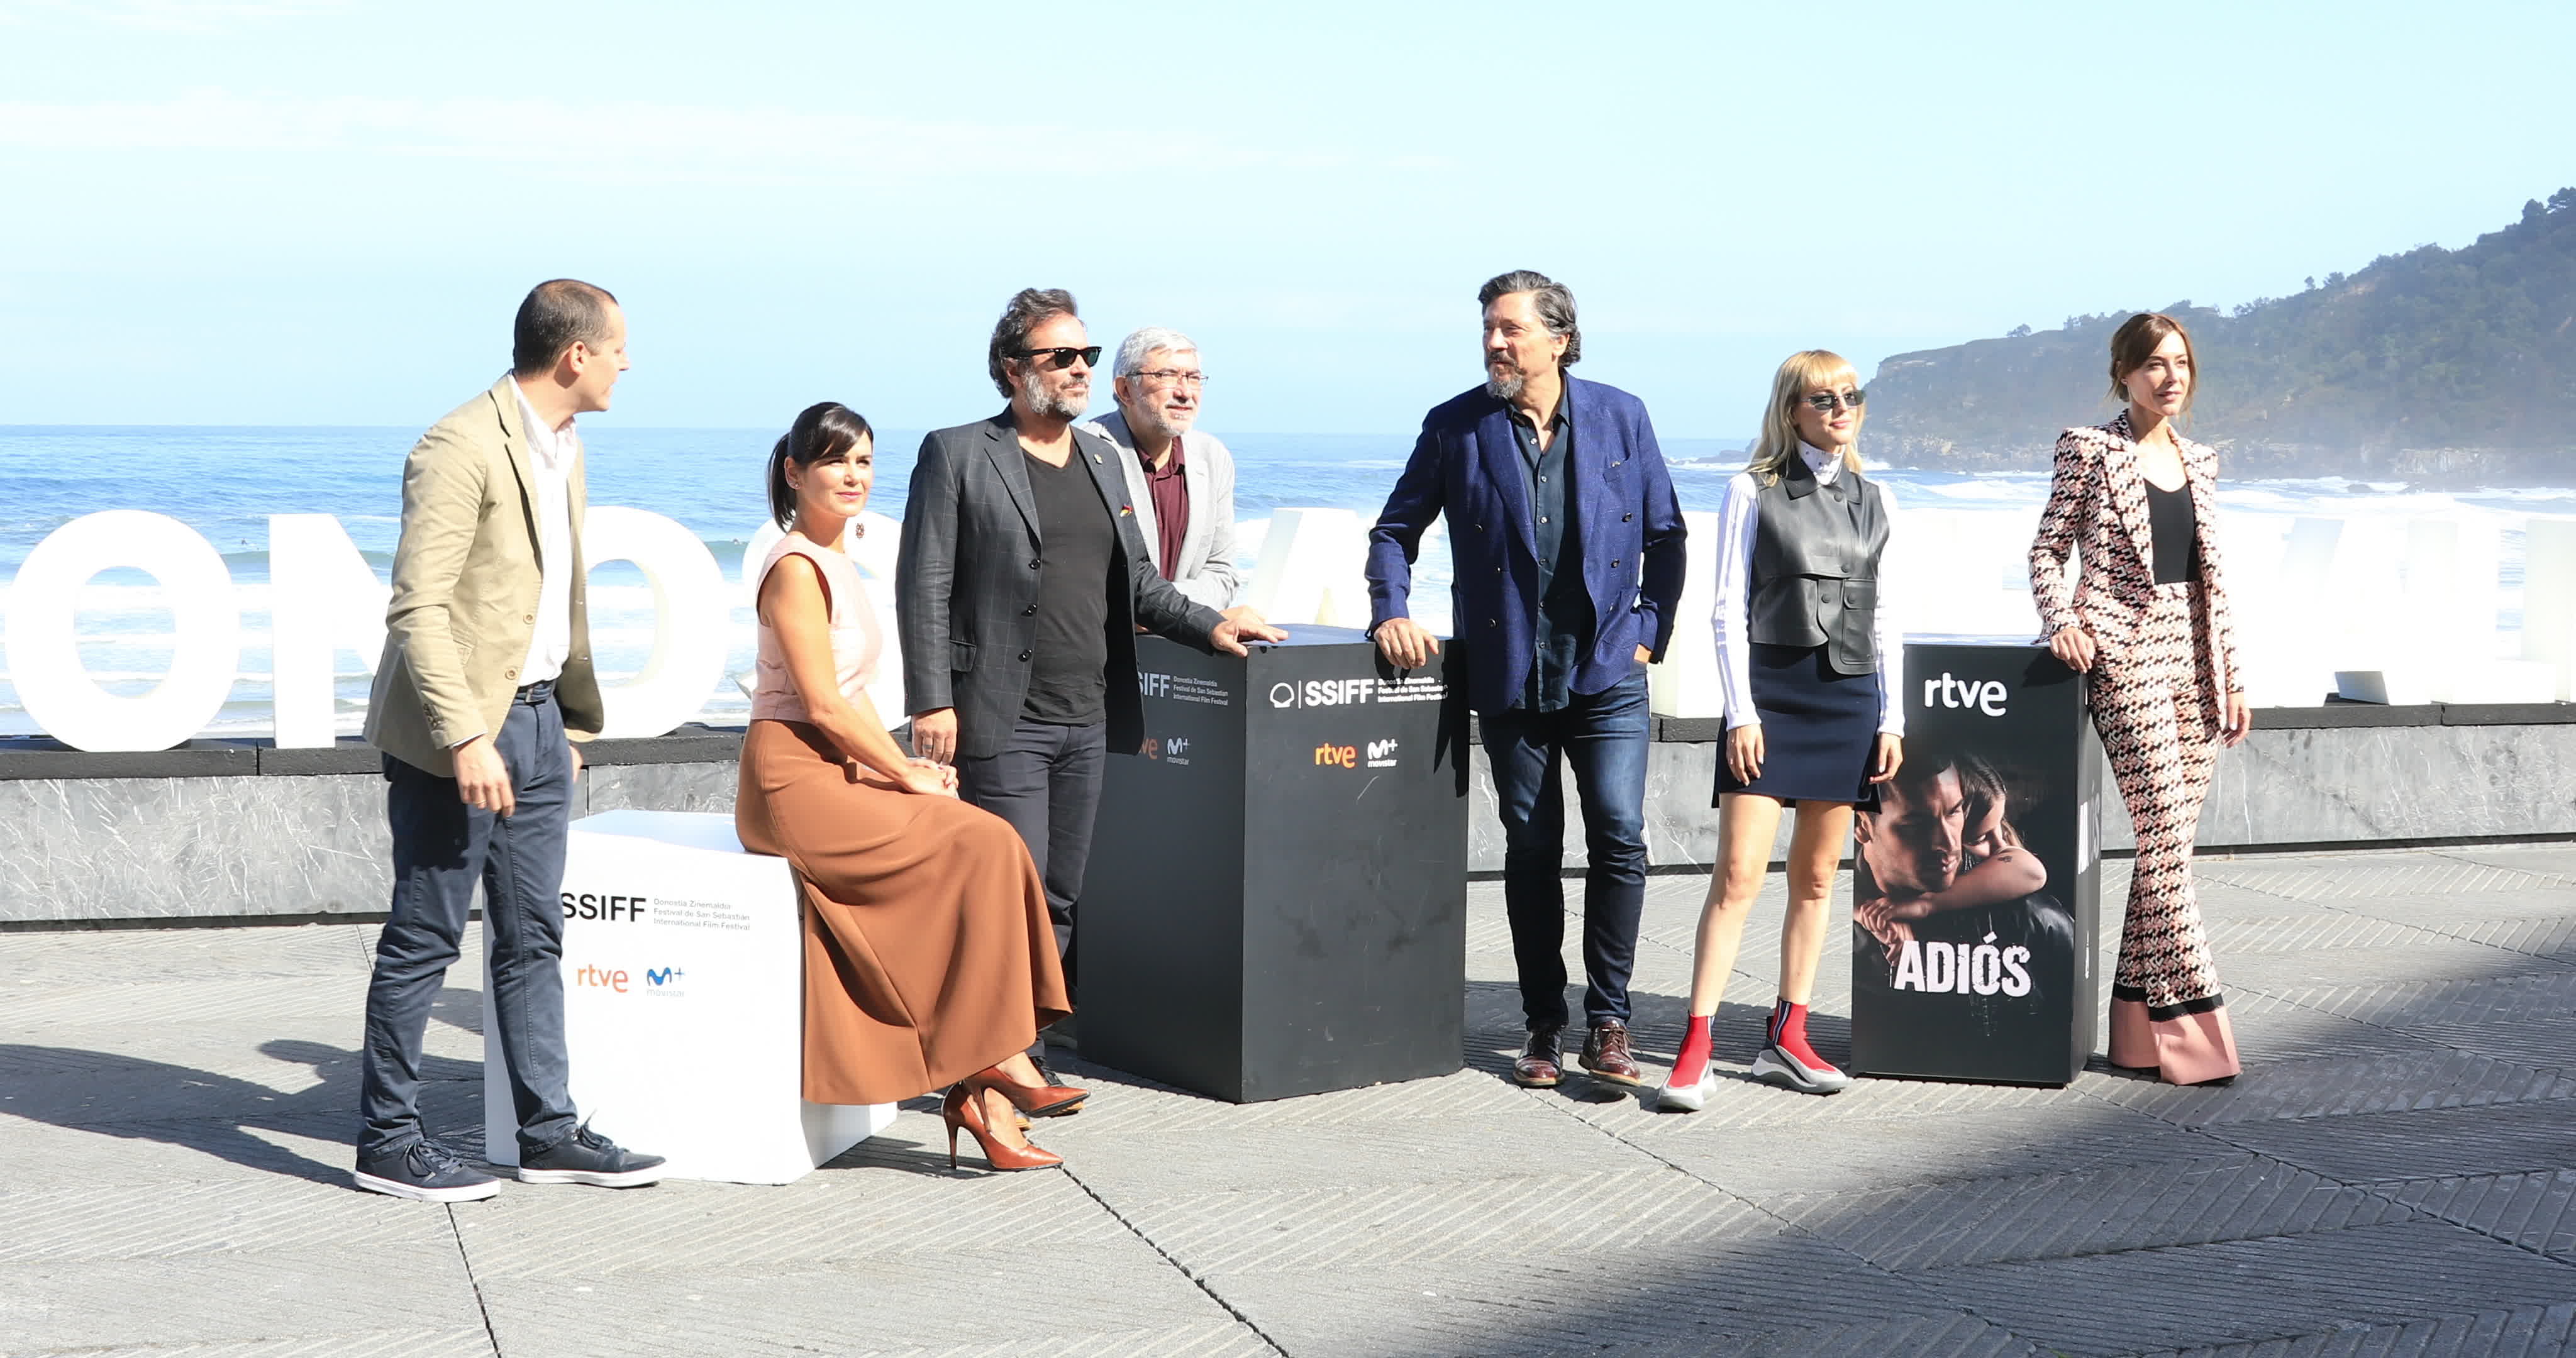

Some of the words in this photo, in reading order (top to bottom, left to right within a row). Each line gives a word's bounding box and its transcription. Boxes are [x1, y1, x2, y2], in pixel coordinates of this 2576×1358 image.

[1305, 679, 1374, 707] SSIFF
[1924, 672, 2008, 717] rtve
[1315, 742, 1357, 768] rtve
[1367, 758, 1397, 768] movistar
[561, 892, 647, 922] SSIFF
[654, 898, 687, 907] Donostia
[689, 900, 731, 910] Zinemaldia
[654, 908, 682, 917] Festival
[696, 910, 710, 919] San
[654, 918, 701, 927] International
[703, 921, 719, 929] Film
[721, 922, 750, 931] Festival
[1894, 931, 2031, 997] ADIÓS
[577, 964, 628, 993] rtve
